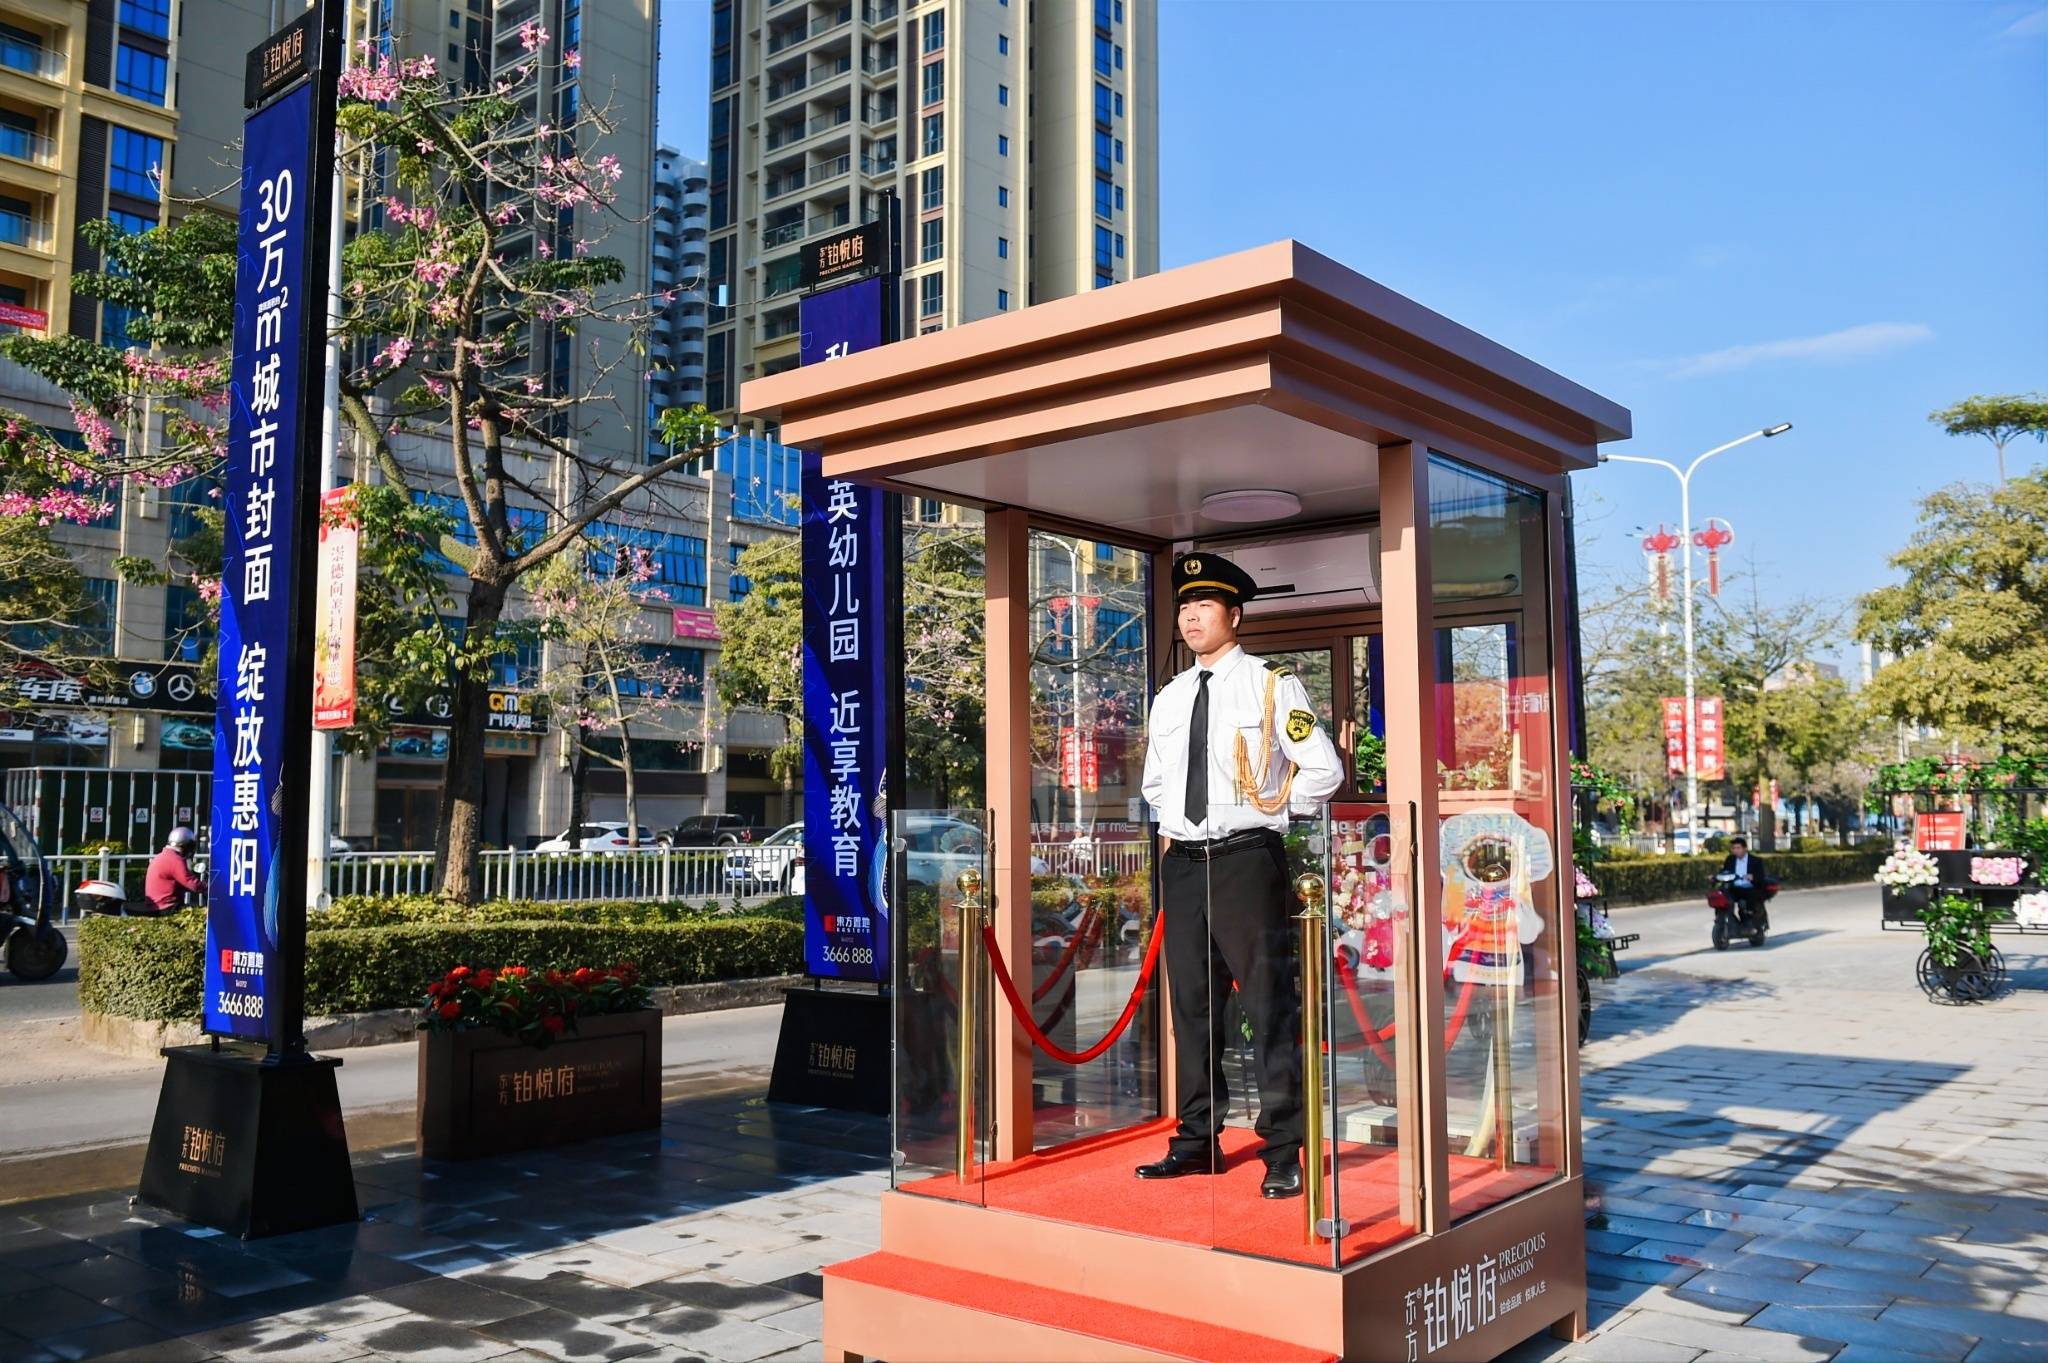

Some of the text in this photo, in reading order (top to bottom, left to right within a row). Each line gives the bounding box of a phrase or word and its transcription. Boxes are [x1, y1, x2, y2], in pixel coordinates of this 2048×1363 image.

[270, 28, 303, 73] 铂悦府
[828, 234, 864, 266] 铂悦府
[229, 641, 266, 897] 绽放惠阳
[829, 689, 861, 877] 近享教育
[232, 966, 264, 976] eastern
[822, 945, 873, 965] 3666 888
[217, 991, 264, 1019] 3666 888
[818, 1044, 857, 1070] 铂悦府
[513, 1064, 575, 1103] 铂悦府
[189, 1127, 226, 1167] 铂悦府
[1498, 1231, 1546, 1270] PRECIOUS
[1499, 1257, 1534, 1287] MANSION
[1423, 1254, 1498, 1354] 铂悦府
